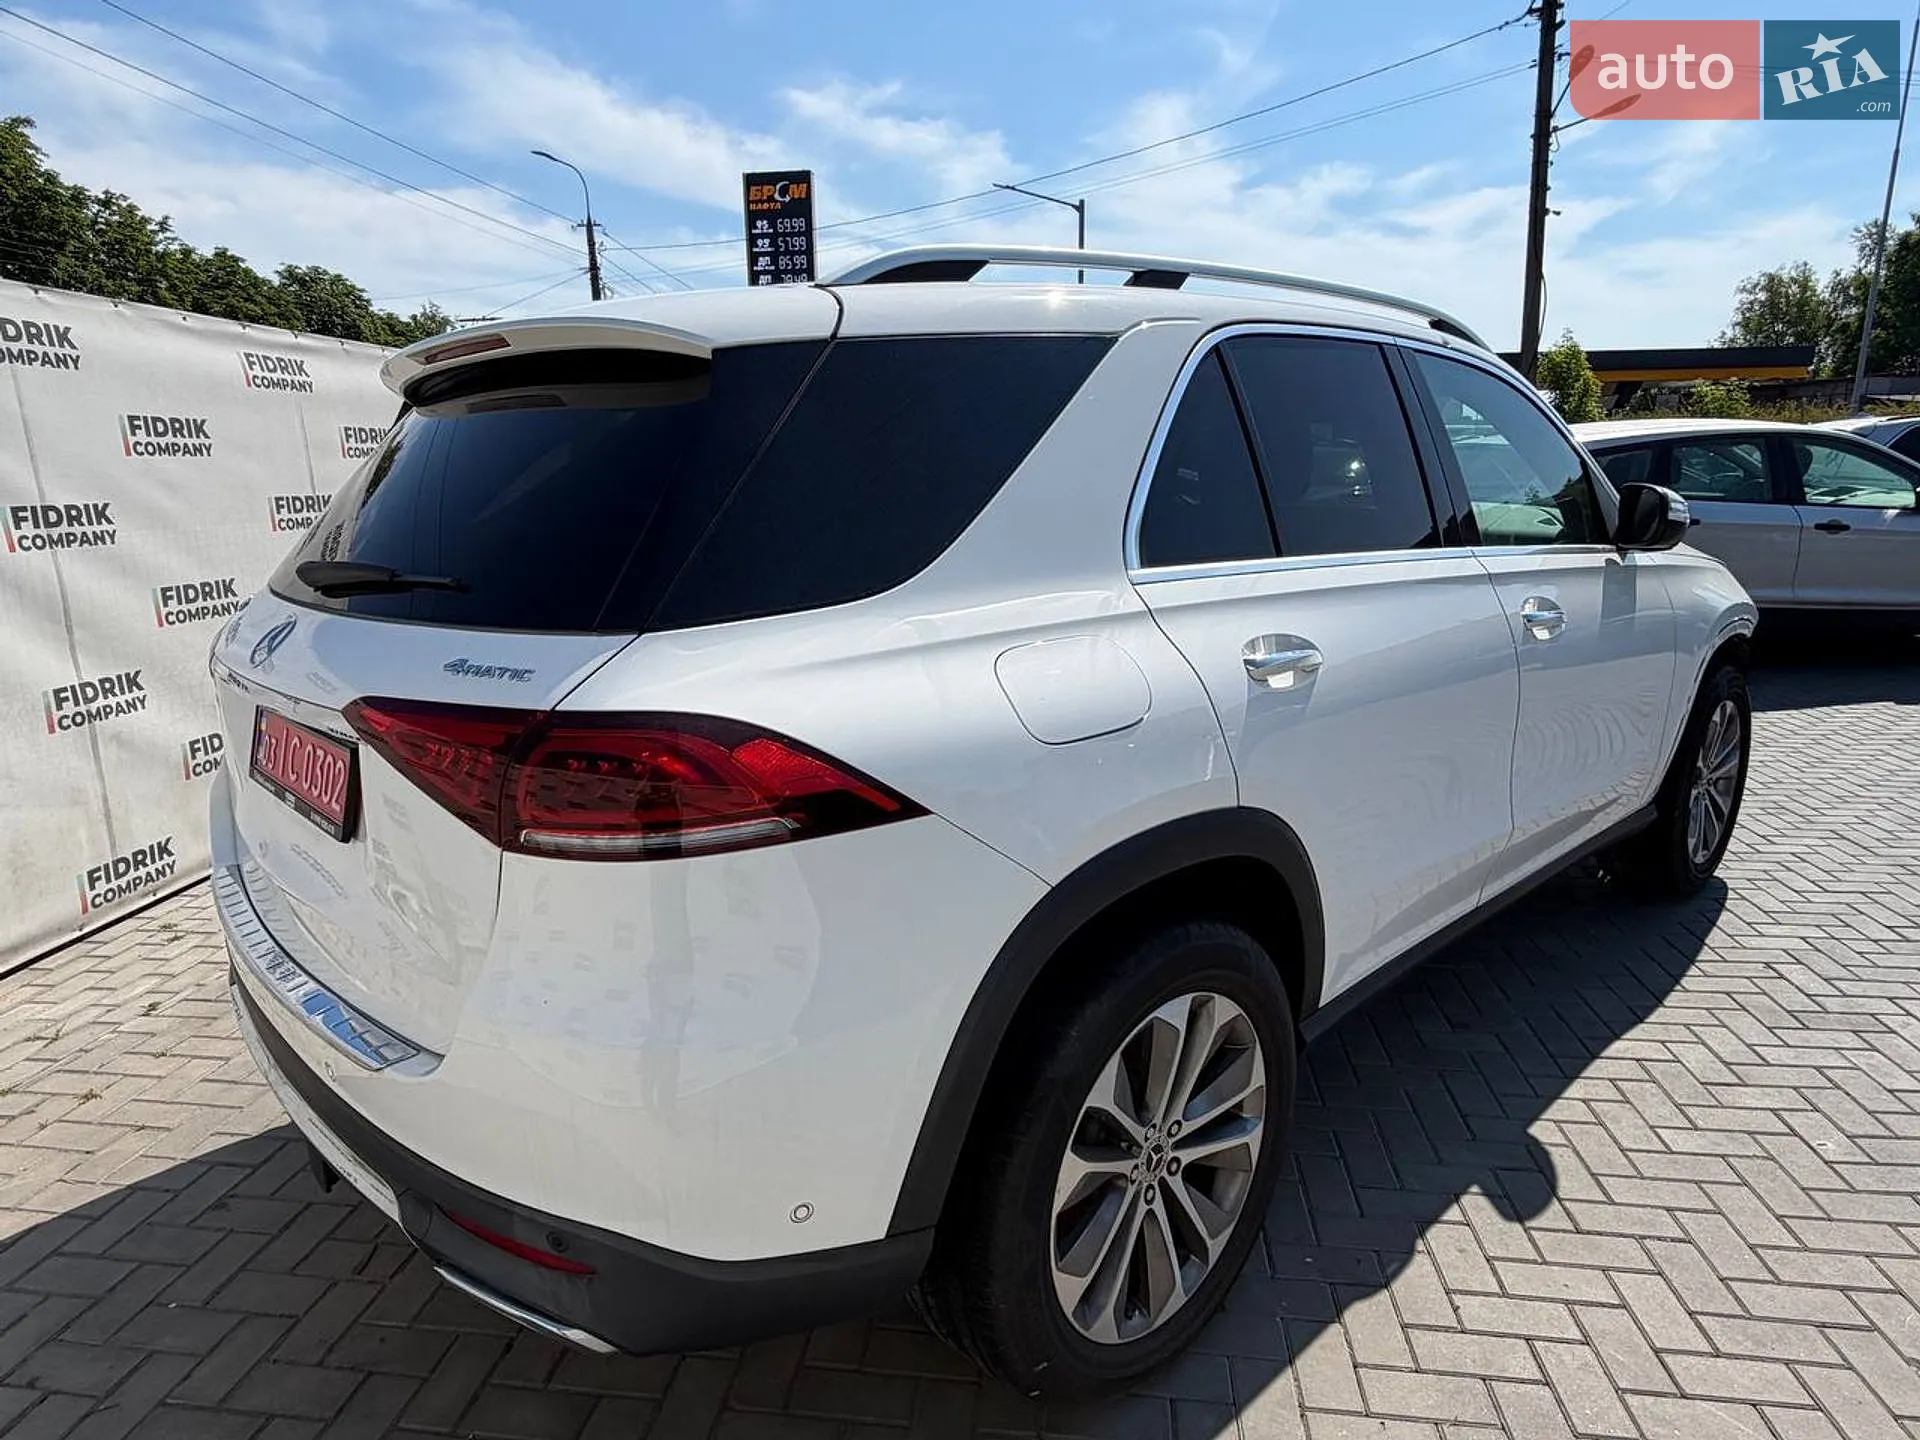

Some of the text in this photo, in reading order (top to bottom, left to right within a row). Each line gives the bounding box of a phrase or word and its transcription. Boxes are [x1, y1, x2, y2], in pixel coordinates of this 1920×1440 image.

[0, 316, 79, 350] DRIK
[243, 351, 310, 378] FIDRIK
[252, 375, 313, 393] COMPANY
[127, 415, 211, 439] FIDRIK
[132, 441, 212, 457] COMPANY
[9, 502, 114, 530] FIDRIK
[278, 516, 317, 531] COMP
[17, 530, 116, 551] COMPANY
[160, 578, 238, 608] FIDRIK
[165, 600, 240, 626] COMPANY
[53, 669, 145, 711] FIDRIK
[57, 695, 147, 731] COMPANY
[189, 733, 224, 760] FID
[302, 742, 347, 812] 0302
[86, 836, 175, 891] FIDRIK
[91, 860, 176, 909] COMPANY
